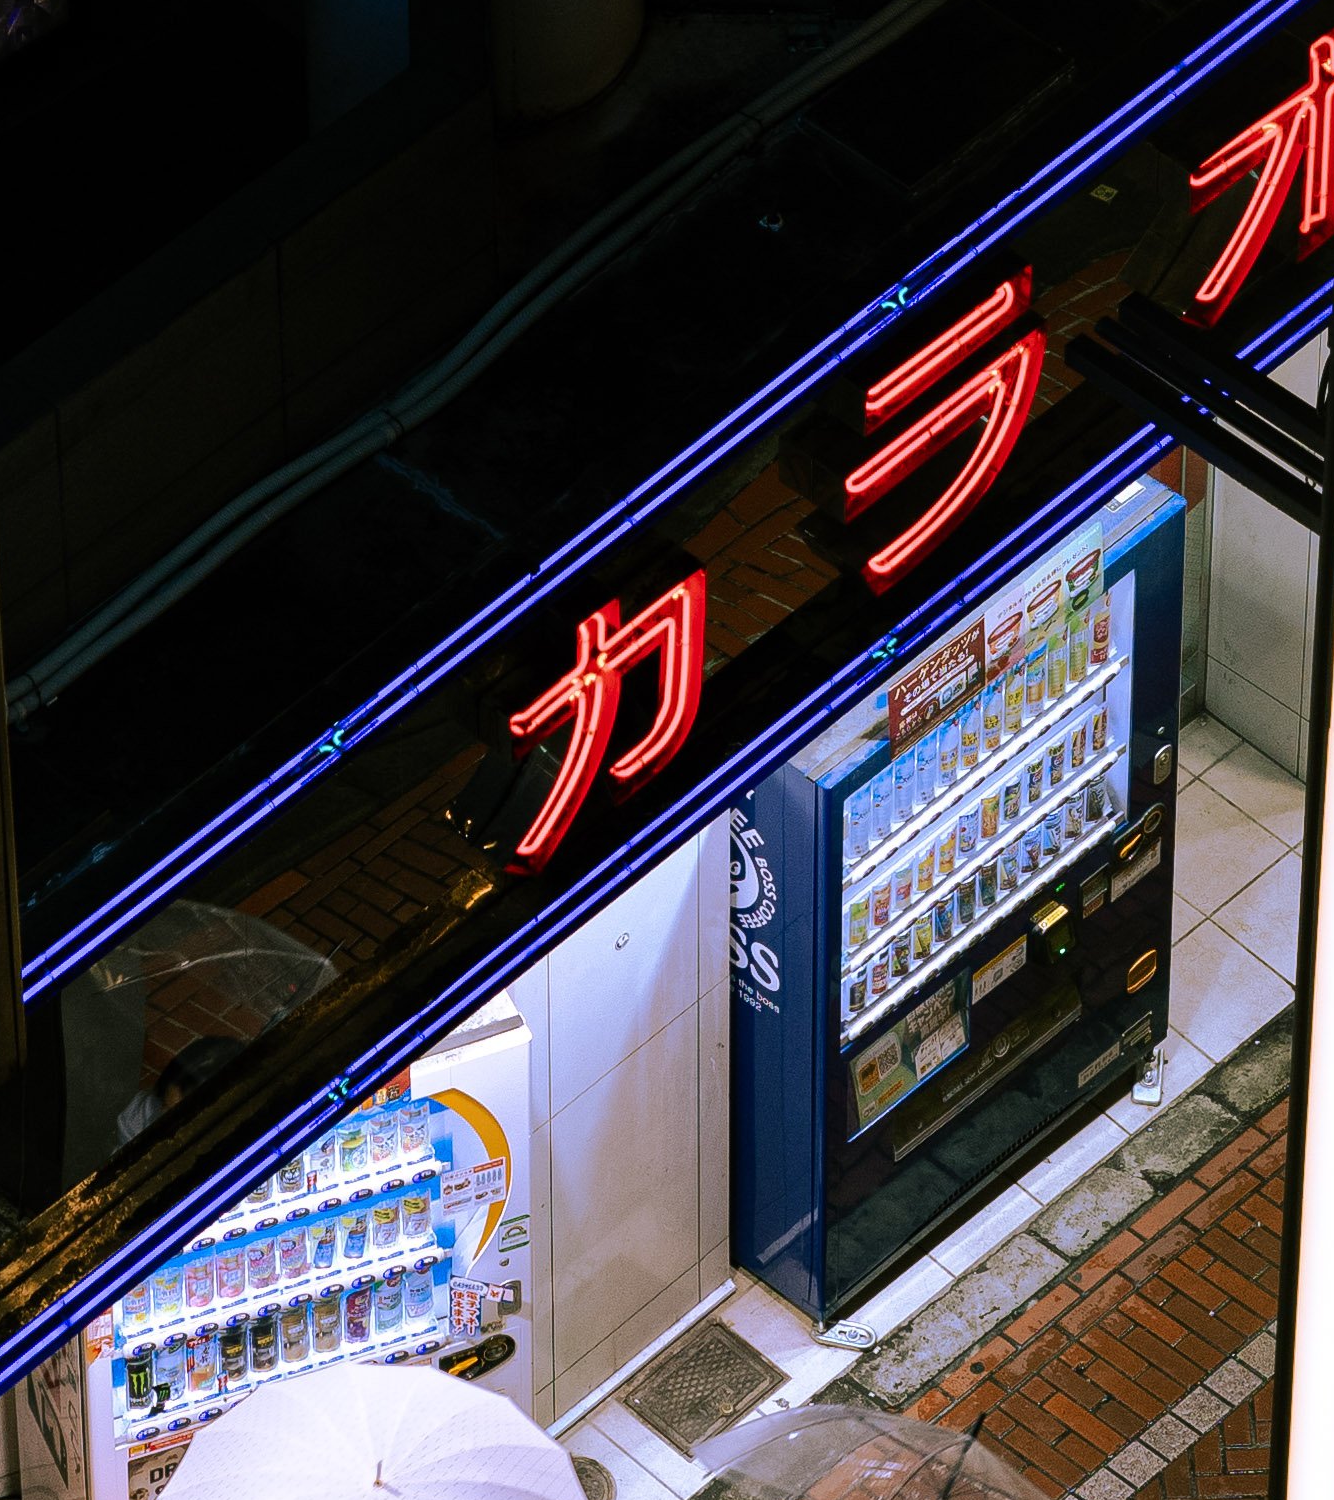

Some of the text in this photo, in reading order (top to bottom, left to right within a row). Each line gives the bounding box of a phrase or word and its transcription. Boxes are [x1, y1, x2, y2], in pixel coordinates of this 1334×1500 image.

[894, 626, 980, 701] ハーゲンダッツが
[736, 856, 777, 929] BOSS COFFEE
[738, 978, 780, 1014] the boss
[738, 989, 762, 1012] 1992
[452, 1290, 465, 1334] 使えます！
[466, 1290, 478, 1334] 電子マネー
